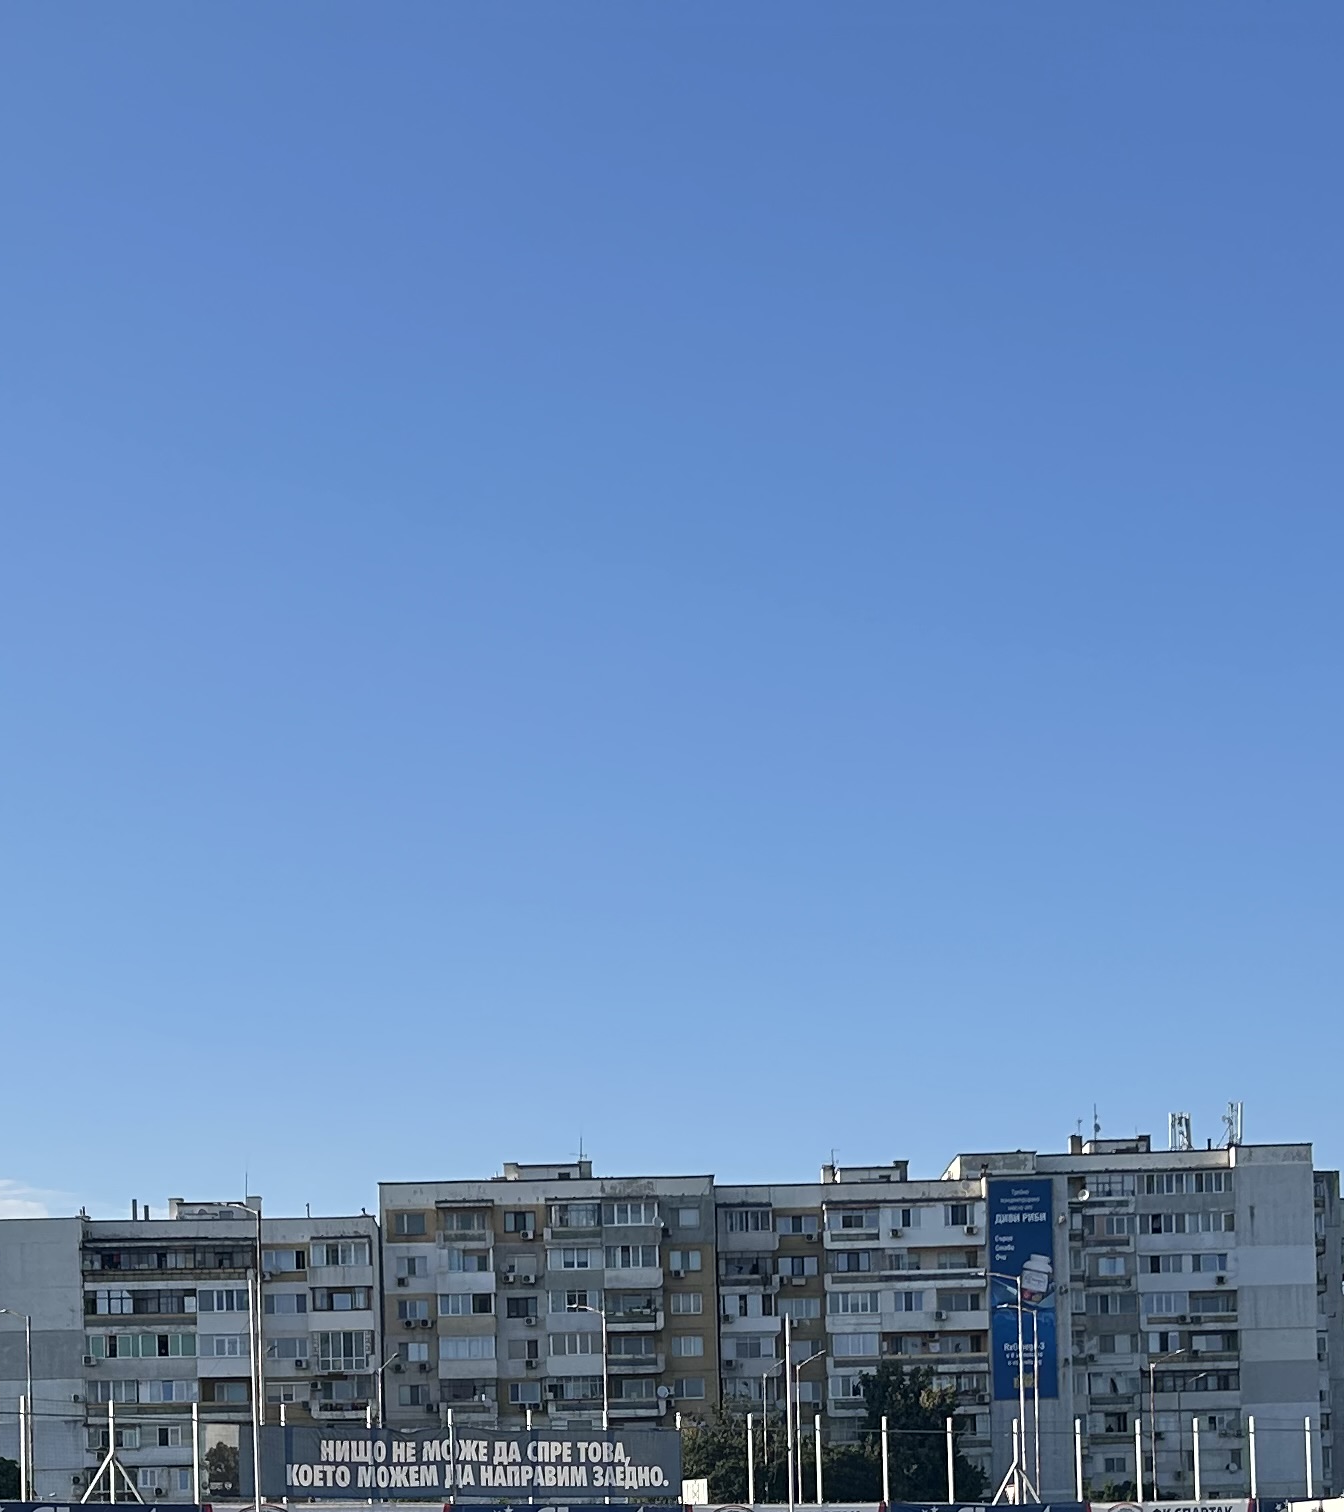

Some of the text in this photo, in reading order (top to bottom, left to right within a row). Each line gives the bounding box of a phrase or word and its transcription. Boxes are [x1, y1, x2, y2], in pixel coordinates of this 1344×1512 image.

[320, 1440, 631, 1467] НИЩО НЕ МОЖЕ ДА СПРЕ ТОВА,
[286, 1465, 670, 1490] КОЕТО МОЖЕМ ДА НАПРАВИМ ЗАЕДНО.
